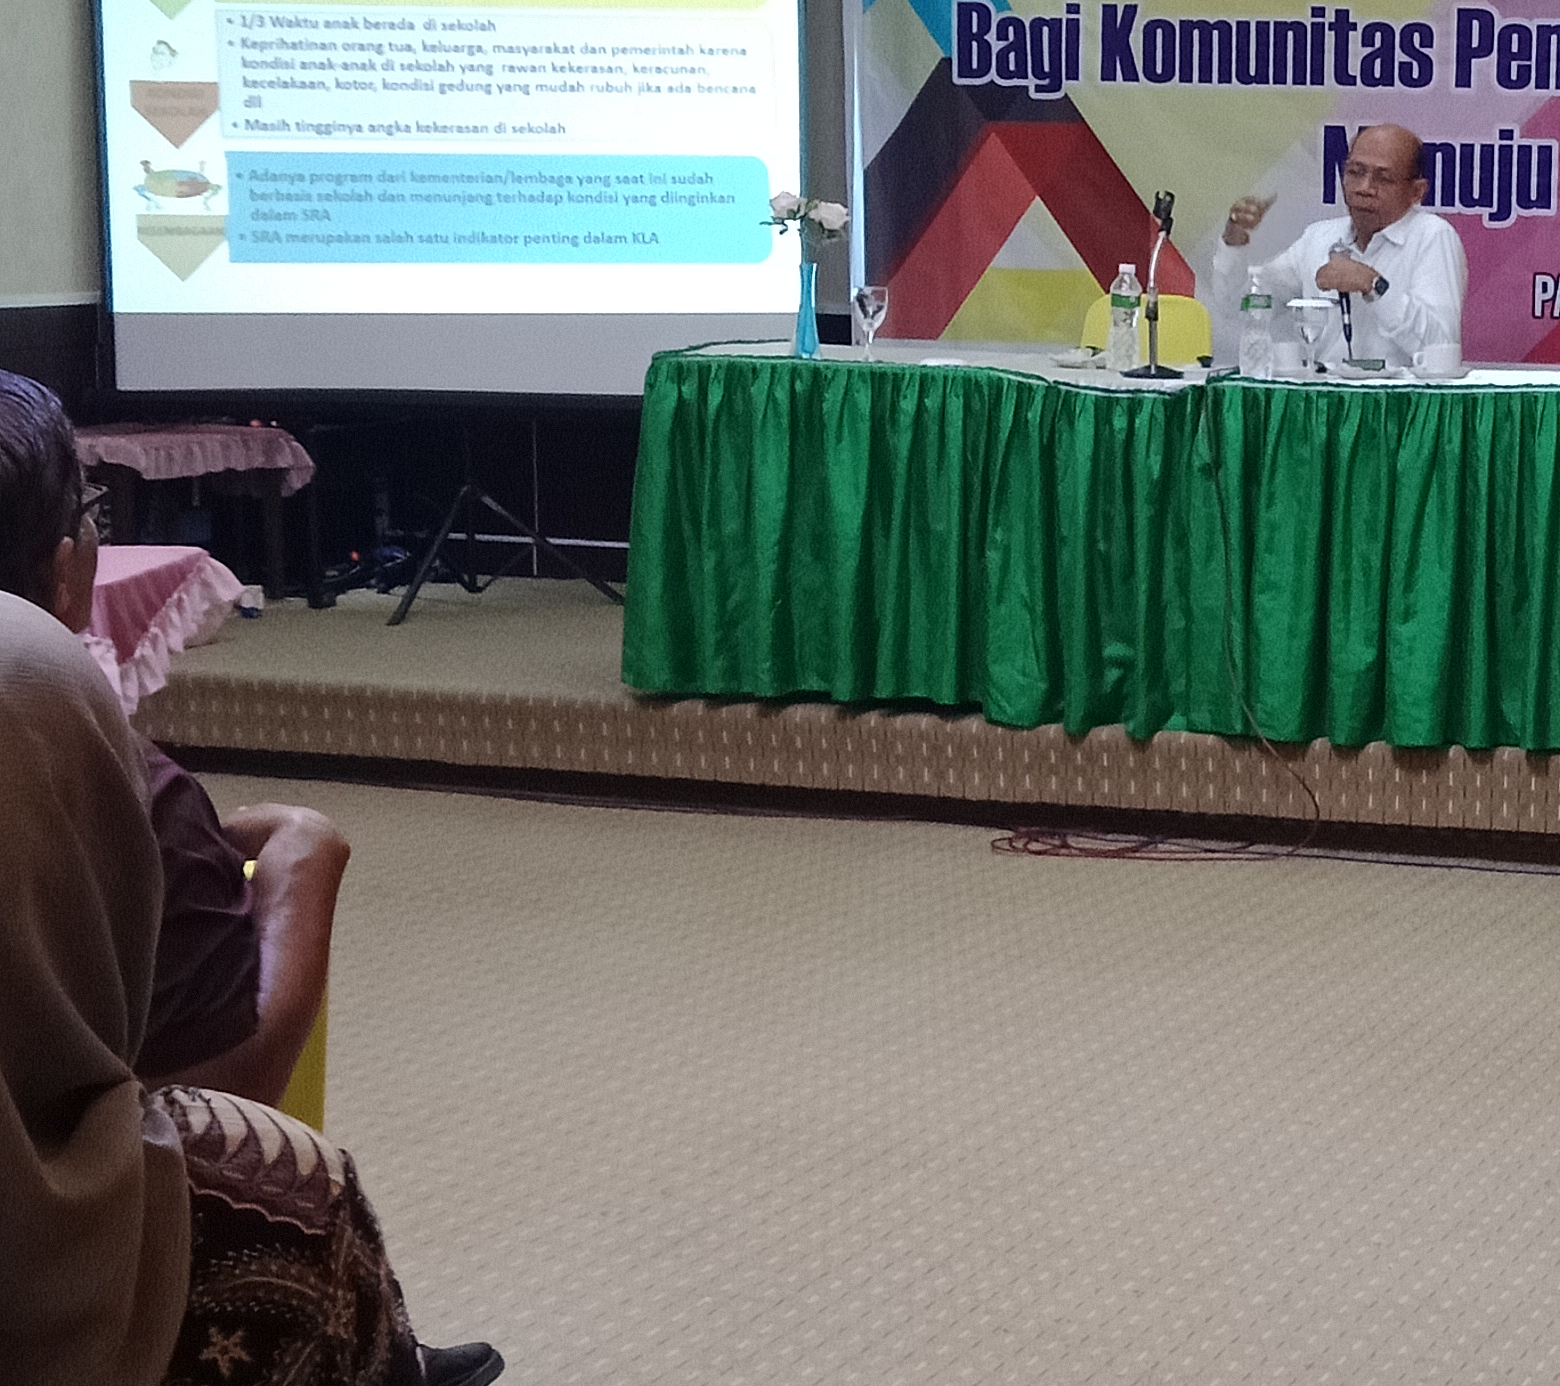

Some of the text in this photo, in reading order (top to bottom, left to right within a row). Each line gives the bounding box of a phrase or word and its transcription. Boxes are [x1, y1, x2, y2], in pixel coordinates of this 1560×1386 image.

[269, 15, 319, 30] Waktu
[323, 16, 360, 30] anak
[364, 17, 415, 31] berada
[423, 18, 437, 31] di
[441, 18, 496, 33] sekolah
[240, 37, 337, 53] Keprihatinan
[342, 41, 385, 55] orang
[493, 42, 576, 58] masyarakat
[580, 42, 607, 55] dan
[611, 43, 695, 58] pemerintah
[699, 44, 747, 56] karena
[955, 0, 1082, 93] Bagi
[1100, 2, 1435, 88] Komunitas
[241, 56, 296, 70] kondisi
[381, 58, 396, 71] di
[400, 58, 455, 72] sekolah
[459, 60, 494, 76] yang
[502, 63, 547, 75] rawan
[382, 78, 434, 92] kondisi
[438, 79, 493, 96] gedung
[496, 82, 531, 96] yang
[535, 81, 585, 94] mudah
[590, 81, 633, 94] rubuh
[637, 82, 662, 96] jika
[667, 82, 692, 95] ada
[697, 82, 757, 95] bencana
[244, 118, 567, 136] Masih tingginya angka kekerasan di sekolah
[249, 169, 306, 185] Adanya
[309, 171, 373, 186] program
[377, 170, 407, 184] dari
[576, 174, 611, 188] yang
[614, 173, 645, 185] saat
[649, 173, 667, 185] ini
[671, 172, 714, 186] sudah
[1323, 124, 1555, 222] Mnuju
[316, 189, 373, 203] sekolah
[377, 189, 406, 203] dan
[410, 191, 493, 207] menunjang
[496, 191, 563, 206] terhadap
[567, 192, 619, 205] kondisi
[623, 193, 657, 207] yang
[661, 191, 736, 207] diinginkan
[250, 207, 332, 223] dalam SRA
[285, 231, 371, 247] merupakan
[376, 230, 414, 244] salah
[417, 231, 449, 244] satu
[453, 231, 519, 245] indikator
[523, 232, 580, 248] penting
[583, 231, 628, 245] dalam
[632, 231, 660, 245] KLA
